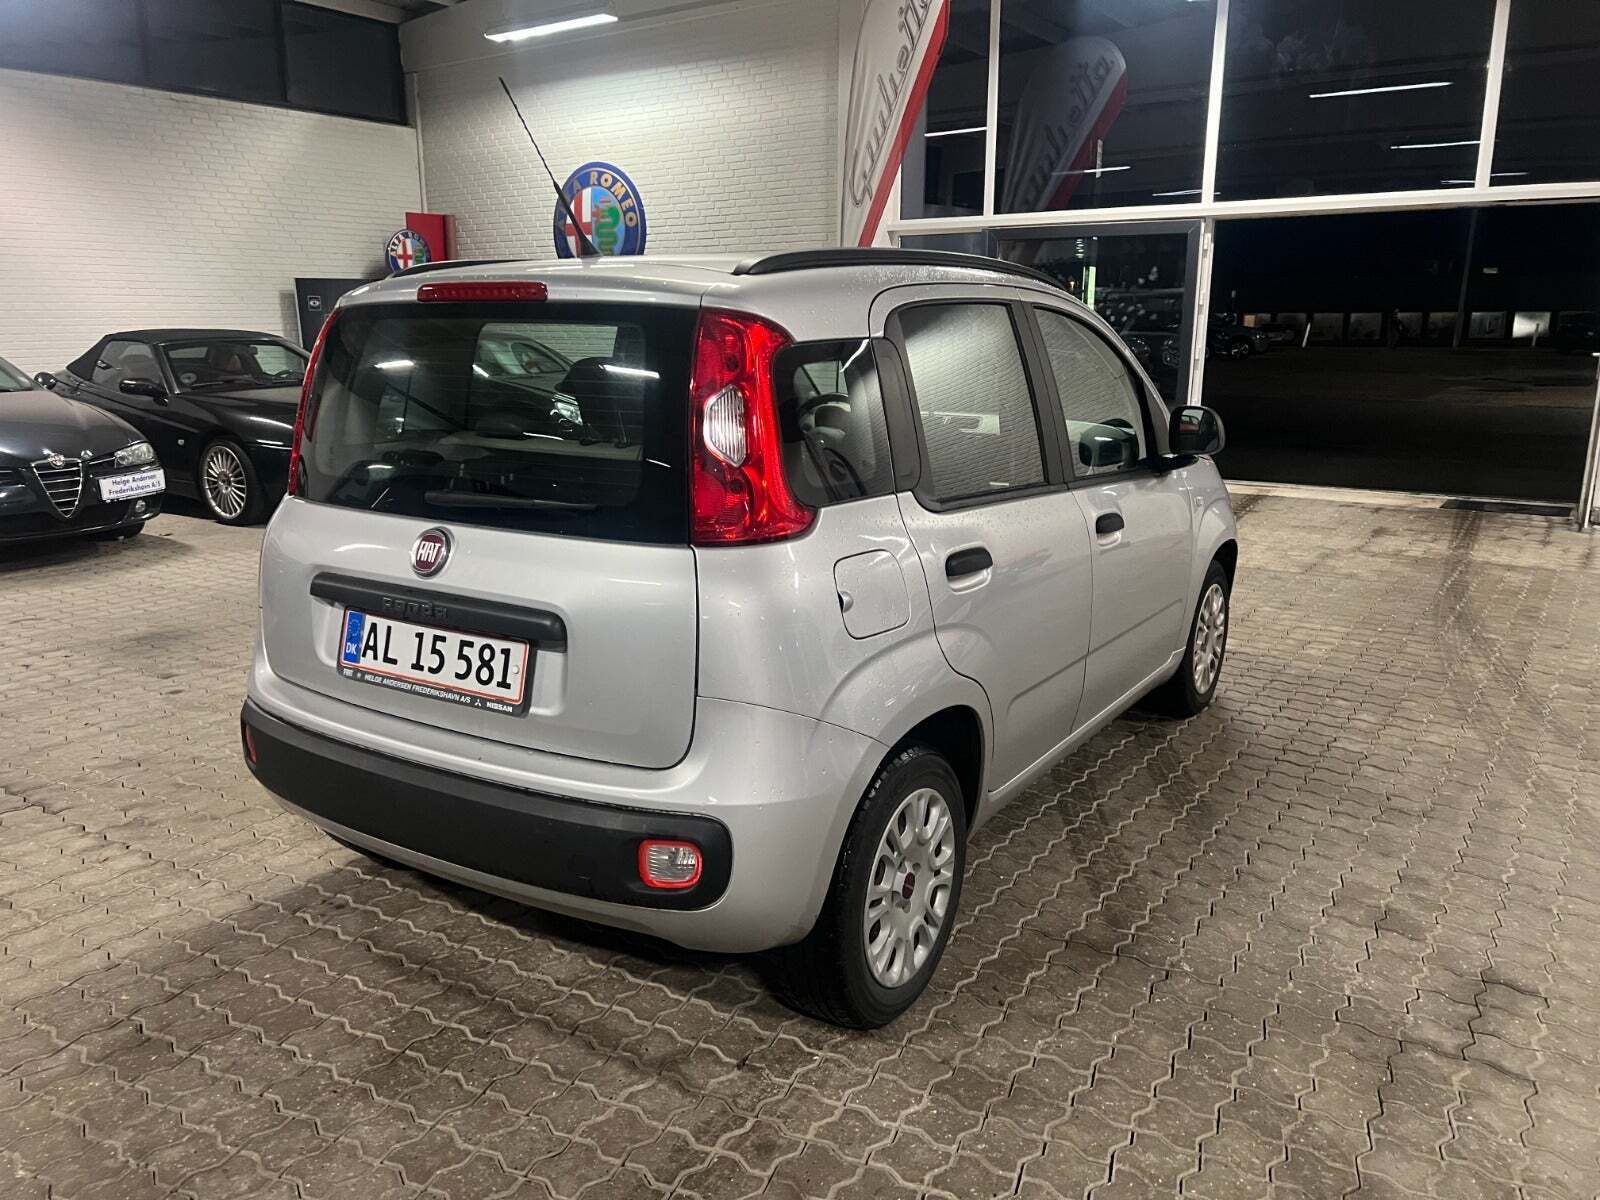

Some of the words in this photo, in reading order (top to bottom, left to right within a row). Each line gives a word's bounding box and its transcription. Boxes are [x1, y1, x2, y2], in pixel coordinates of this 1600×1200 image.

[590, 171, 638, 228] ROMEO
[417, 540, 441, 563] FIAT
[345, 641, 357, 656] DK
[361, 622, 398, 666] AL
[410, 631, 447, 675] 15
[454, 639, 512, 690] 581
[364, 673, 382, 684] HELGE
[382, 678, 412, 690] ANDERSEN
[411, 683, 460, 701] FREDERIKSHAVN
[460, 695, 471, 704] A/S
[486, 701, 513, 713] NISSAN
